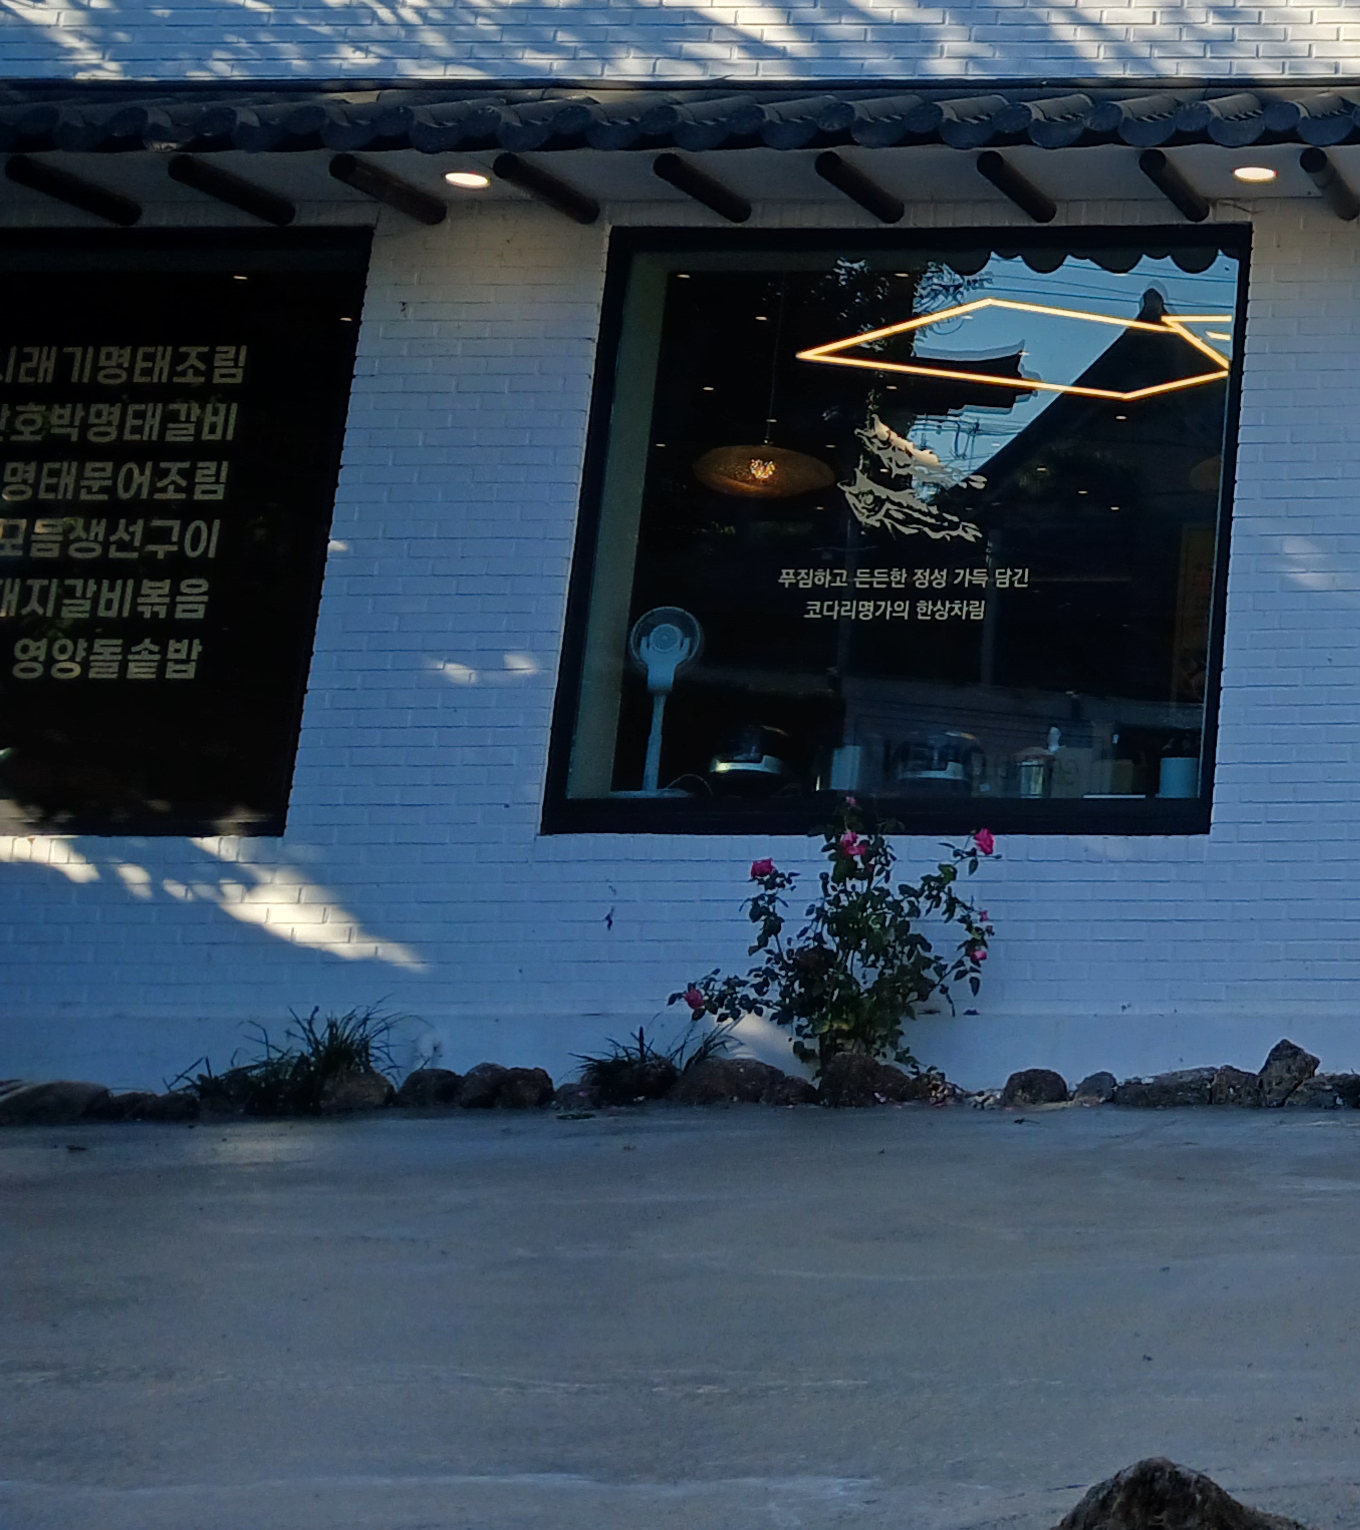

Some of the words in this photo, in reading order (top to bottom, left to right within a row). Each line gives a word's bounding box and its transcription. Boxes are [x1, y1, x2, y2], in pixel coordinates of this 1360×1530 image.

[0, 401, 238, 443] 호박명태갈비
[777, 568, 848, 589] 푸짐하고
[853, 568, 908, 588] 든든한
[912, 568, 948, 588] 정성
[952, 568, 989, 588] 가득
[994, 568, 1030, 588] 담긴
[803, 600, 910, 620] 코다리명가의
[916, 600, 986, 620] 한상차림
[12, 637, 203, 680] 영양돌솥밥
